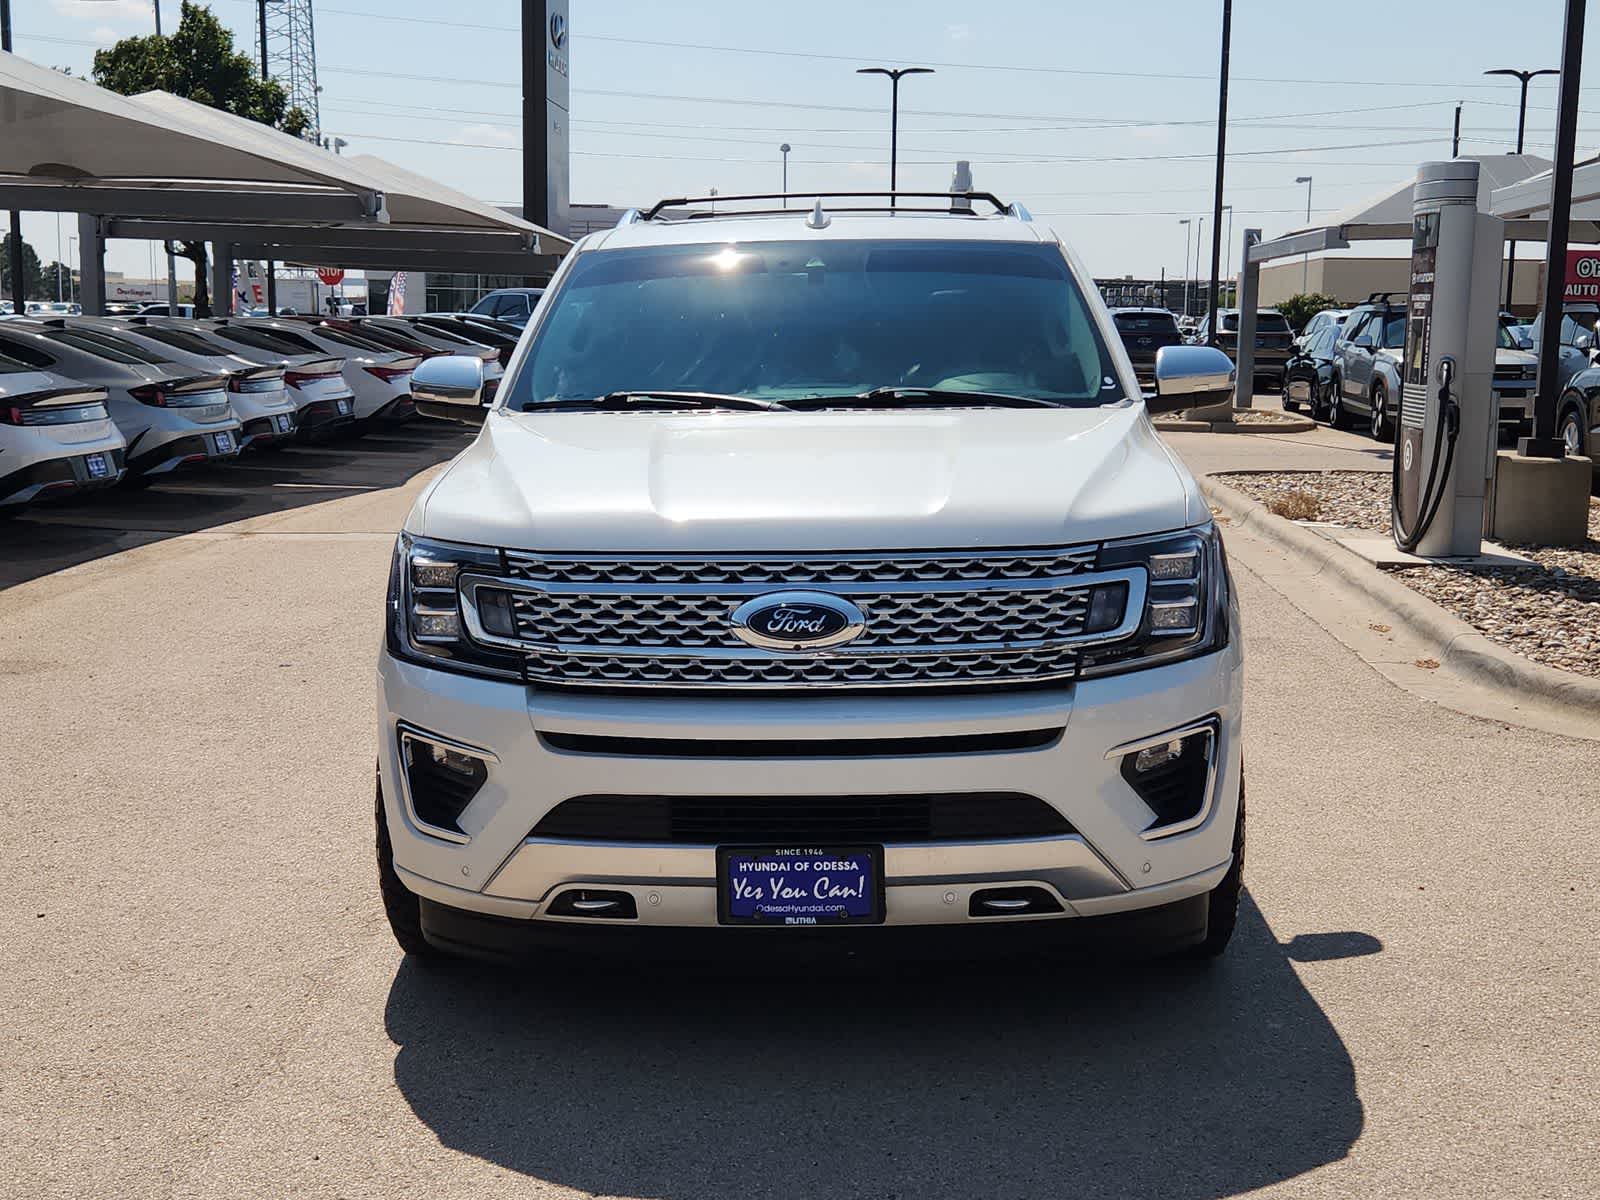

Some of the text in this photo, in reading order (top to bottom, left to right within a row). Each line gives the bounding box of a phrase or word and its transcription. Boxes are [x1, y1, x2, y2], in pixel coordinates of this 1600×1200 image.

[1564, 284, 1599, 296] AUTO
[767, 608, 827, 633] Ford
[804, 848, 824, 856] 1946
[739, 861, 859, 872] HYUNDAI OF ODESSA
[733, 875, 865, 900] Yes You Can!
[756, 904, 845, 914] OdessaHyundai.com
[791, 917, 817, 925] LITHIA
